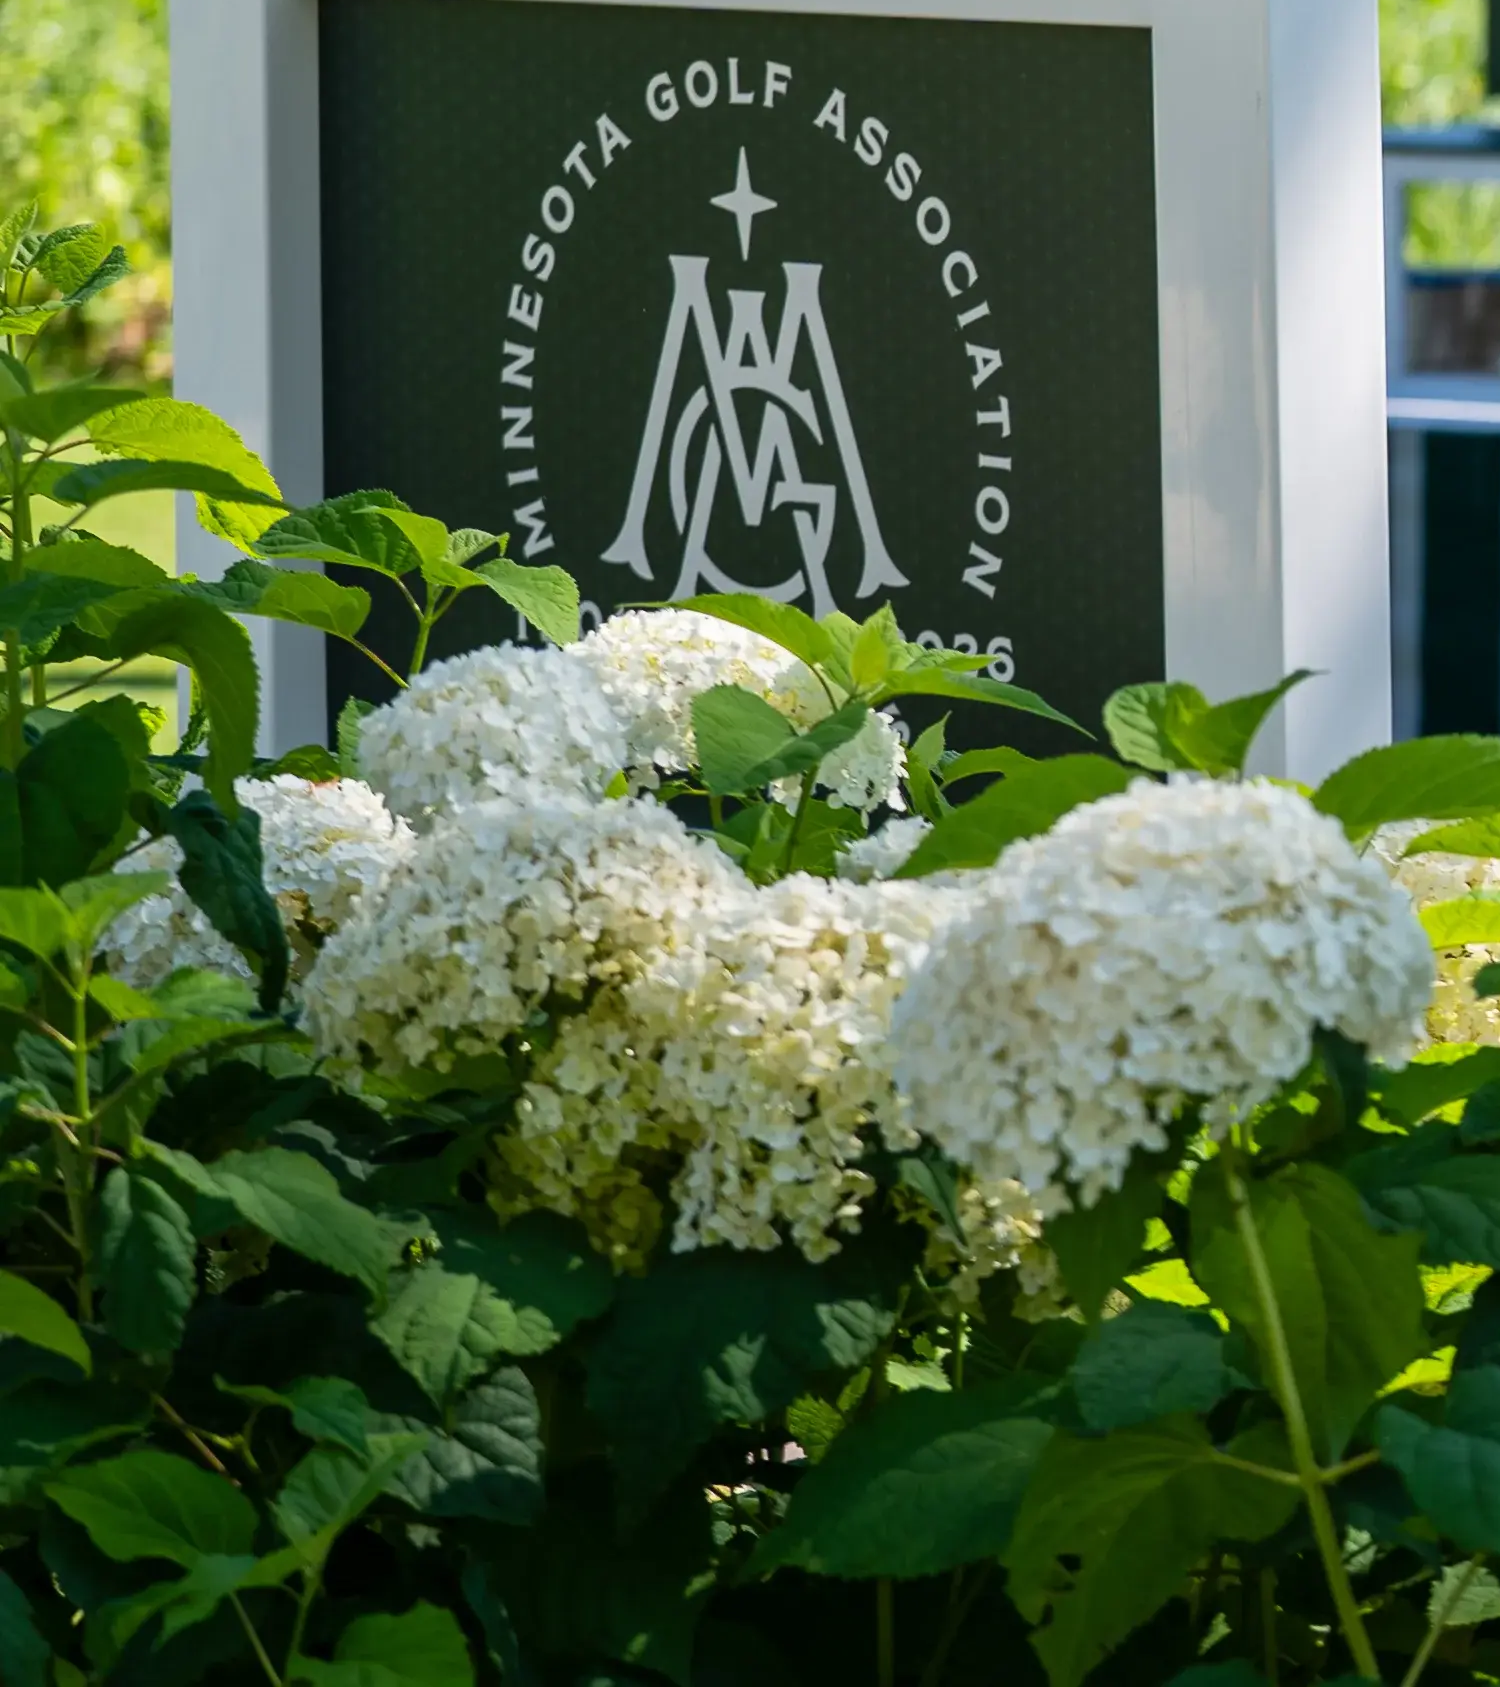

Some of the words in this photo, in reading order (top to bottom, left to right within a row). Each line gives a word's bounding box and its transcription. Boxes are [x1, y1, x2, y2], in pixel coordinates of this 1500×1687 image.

[501, 112, 632, 559] MINNESOTA
[645, 57, 793, 122] GOLF
[812, 87, 1013, 599] ASSOCIATION
